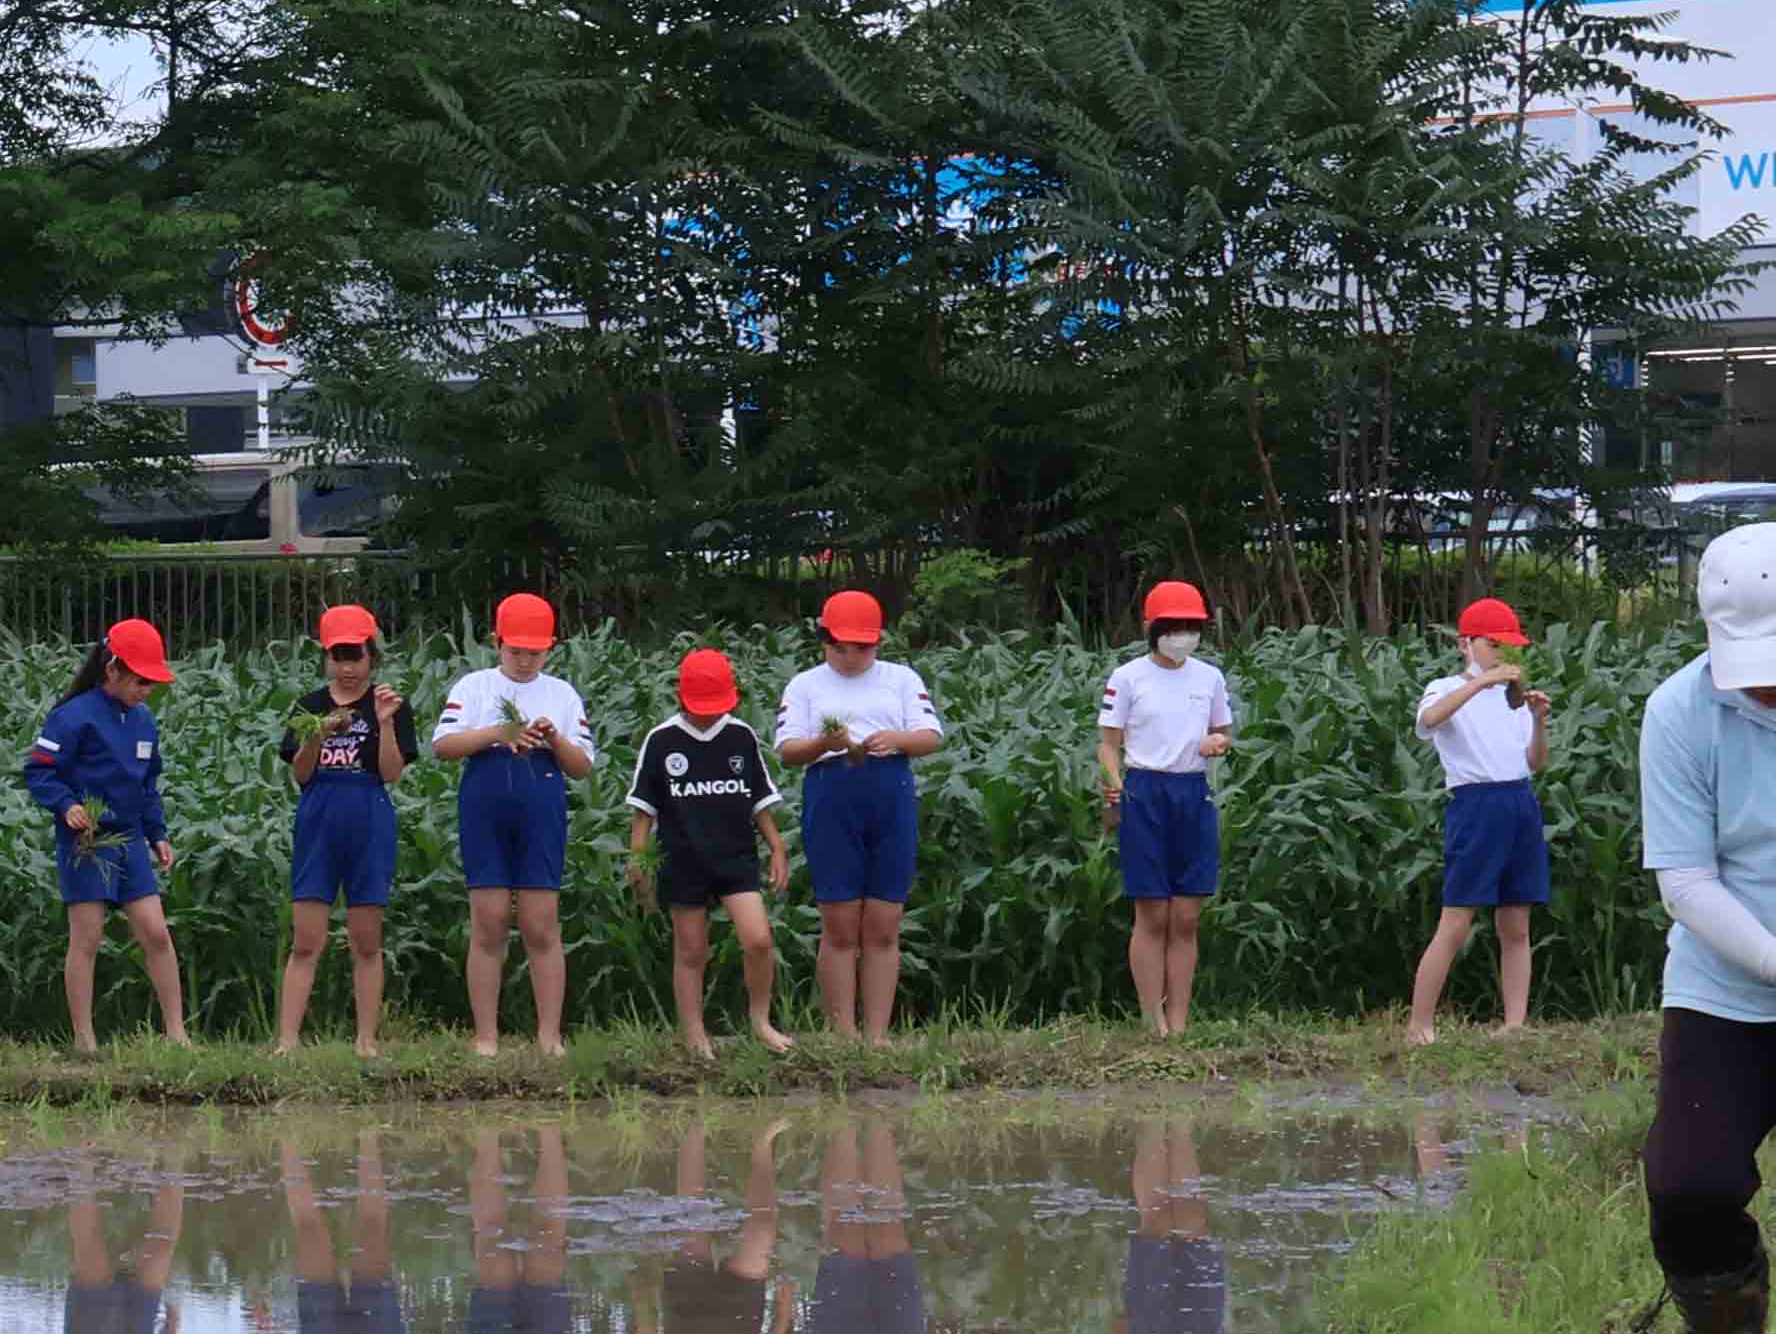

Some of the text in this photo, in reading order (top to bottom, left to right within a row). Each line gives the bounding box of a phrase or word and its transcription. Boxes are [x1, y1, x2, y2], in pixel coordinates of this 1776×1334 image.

[1723, 153, 1776, 190] W
[320, 748, 360, 764] DAY
[669, 779, 752, 798] KANGOL
